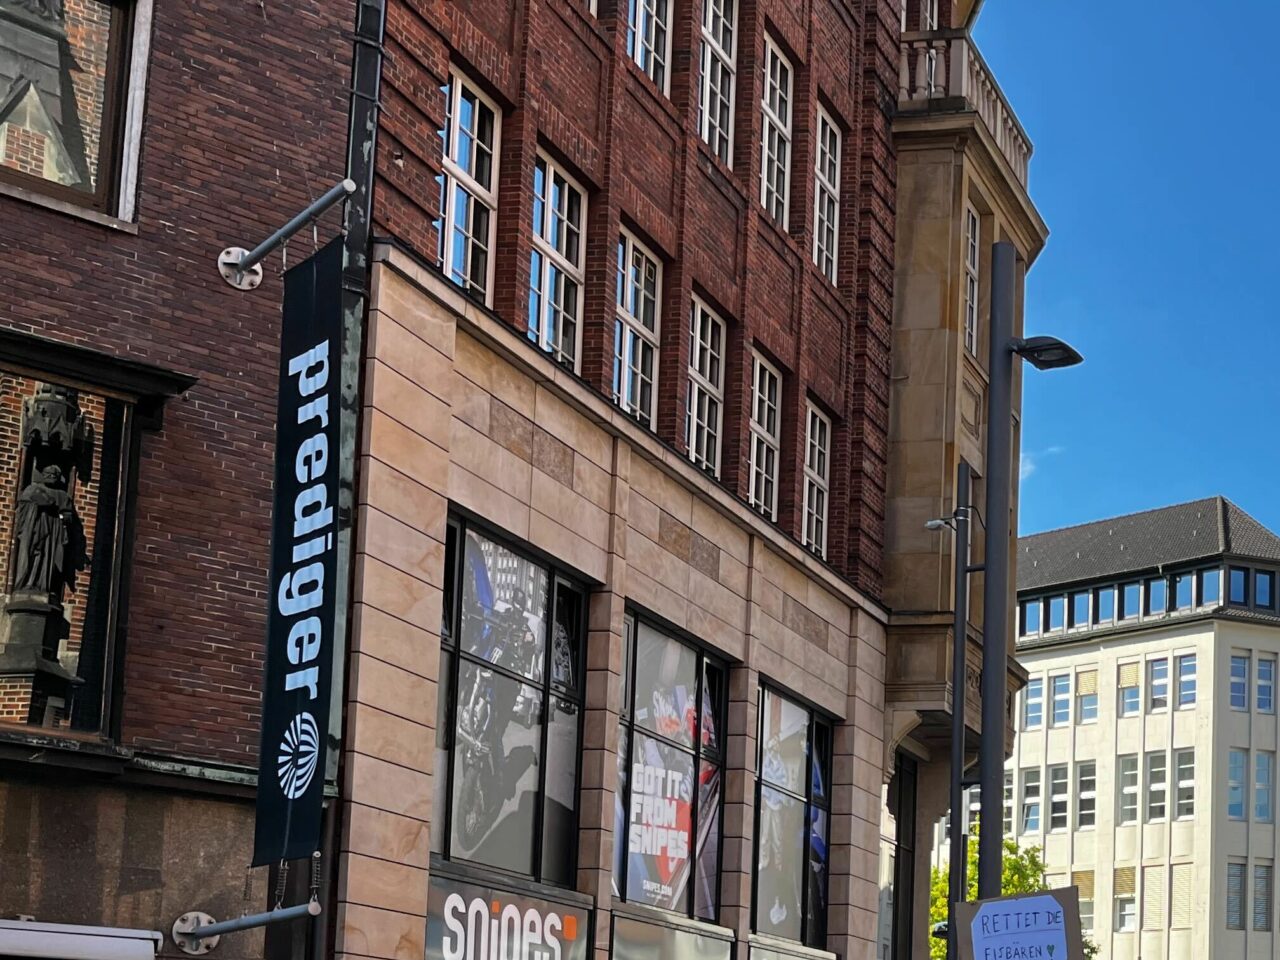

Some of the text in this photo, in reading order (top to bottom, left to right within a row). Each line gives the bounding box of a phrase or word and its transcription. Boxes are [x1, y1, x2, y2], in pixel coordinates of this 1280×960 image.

[277, 339, 333, 700] prediger
[633, 763, 665, 795] GOT
[666, 769, 683, 799] IT
[631, 794, 677, 828] FROM
[629, 825, 689, 859] SNIPES
[981, 911, 1041, 935] RETTET
